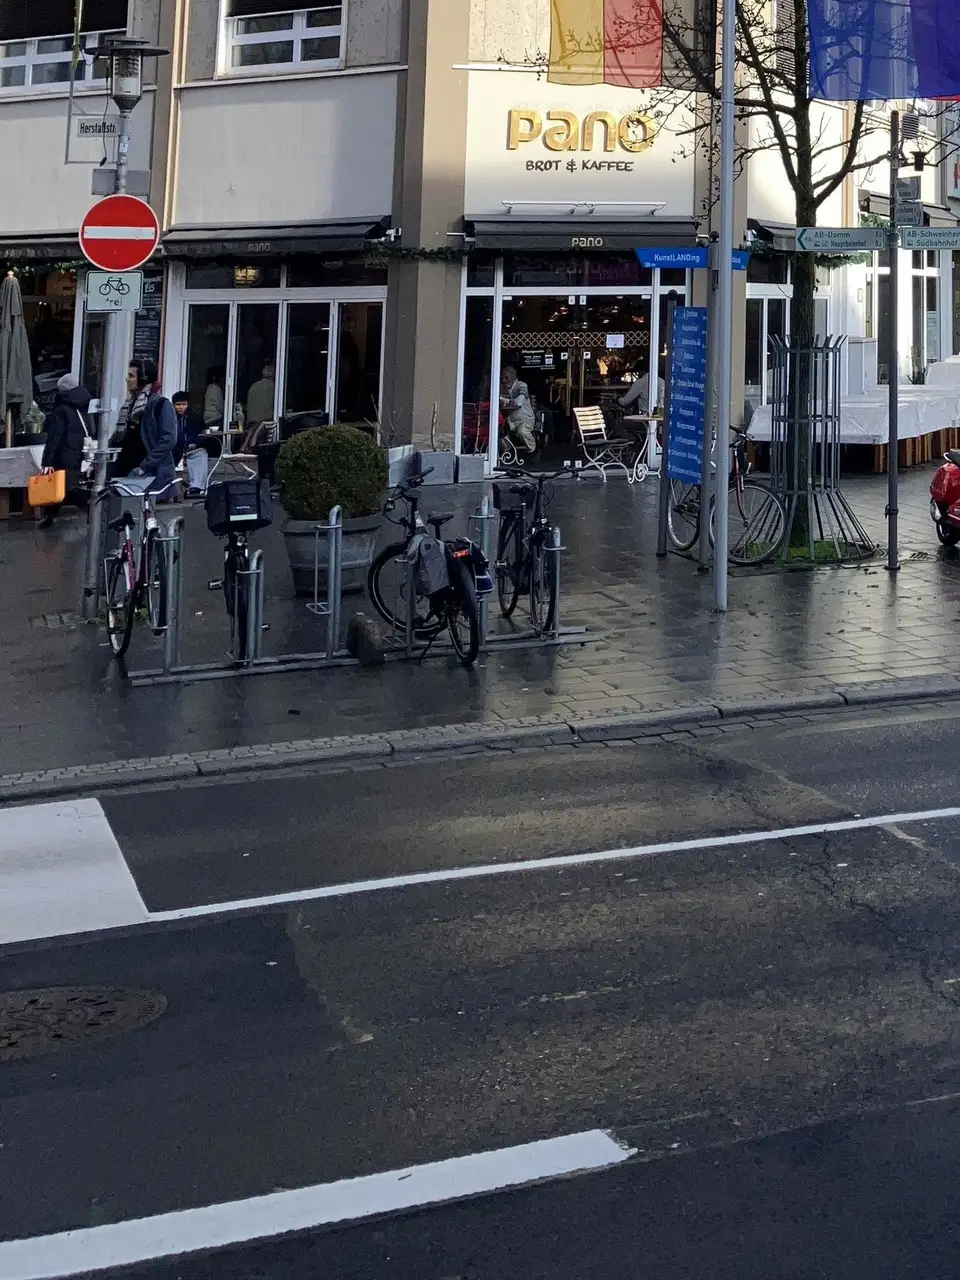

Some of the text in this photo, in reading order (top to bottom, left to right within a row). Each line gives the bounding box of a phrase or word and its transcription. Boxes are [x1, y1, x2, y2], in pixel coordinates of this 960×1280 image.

[507, 109, 657, 153] pano
[525, 158, 634, 173] BROT & KAFFEE
[248, 242, 270, 252] pano
[571, 237, 603, 247] pano
[654, 253, 700, 263] KunstLANDing
